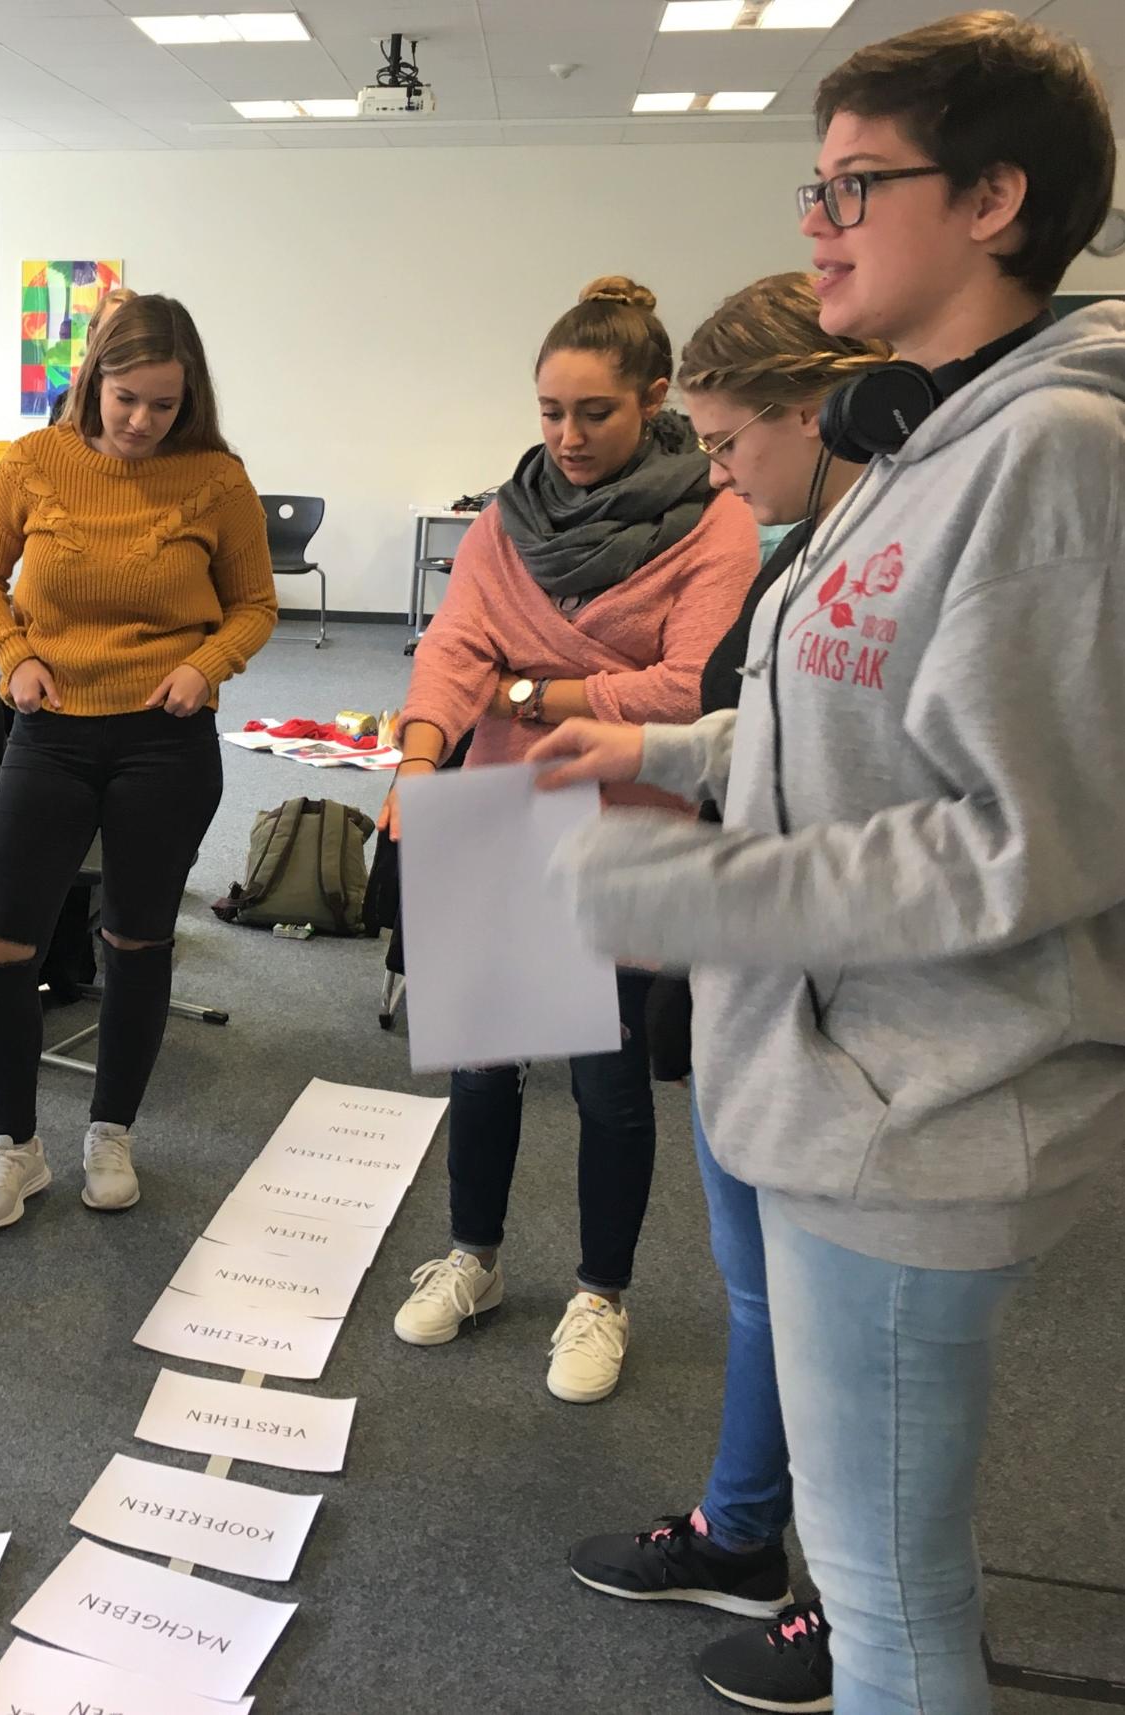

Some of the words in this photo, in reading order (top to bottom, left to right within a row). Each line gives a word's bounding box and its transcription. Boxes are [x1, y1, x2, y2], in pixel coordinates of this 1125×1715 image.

[796, 631, 889, 690] FAKS-AK
[340, 1101, 403, 1117] FRIEDEN
[328, 1125, 386, 1141] LIEBEN
[284, 1145, 401, 1171] RESPEKTIEREN
[258, 1182, 376, 1211] AKZEPTIEREN
[264, 1224, 329, 1244] HELFEN
[214, 1267, 321, 1296] VERSÖHNEN
[183, 1321, 293, 1352] VERZEIHEN
[185, 1408, 307, 1440] VERSTEHEN
[118, 1494, 275, 1544] KOOPERIEREN
[76, 1590, 233, 1655] NACHGEBEN
